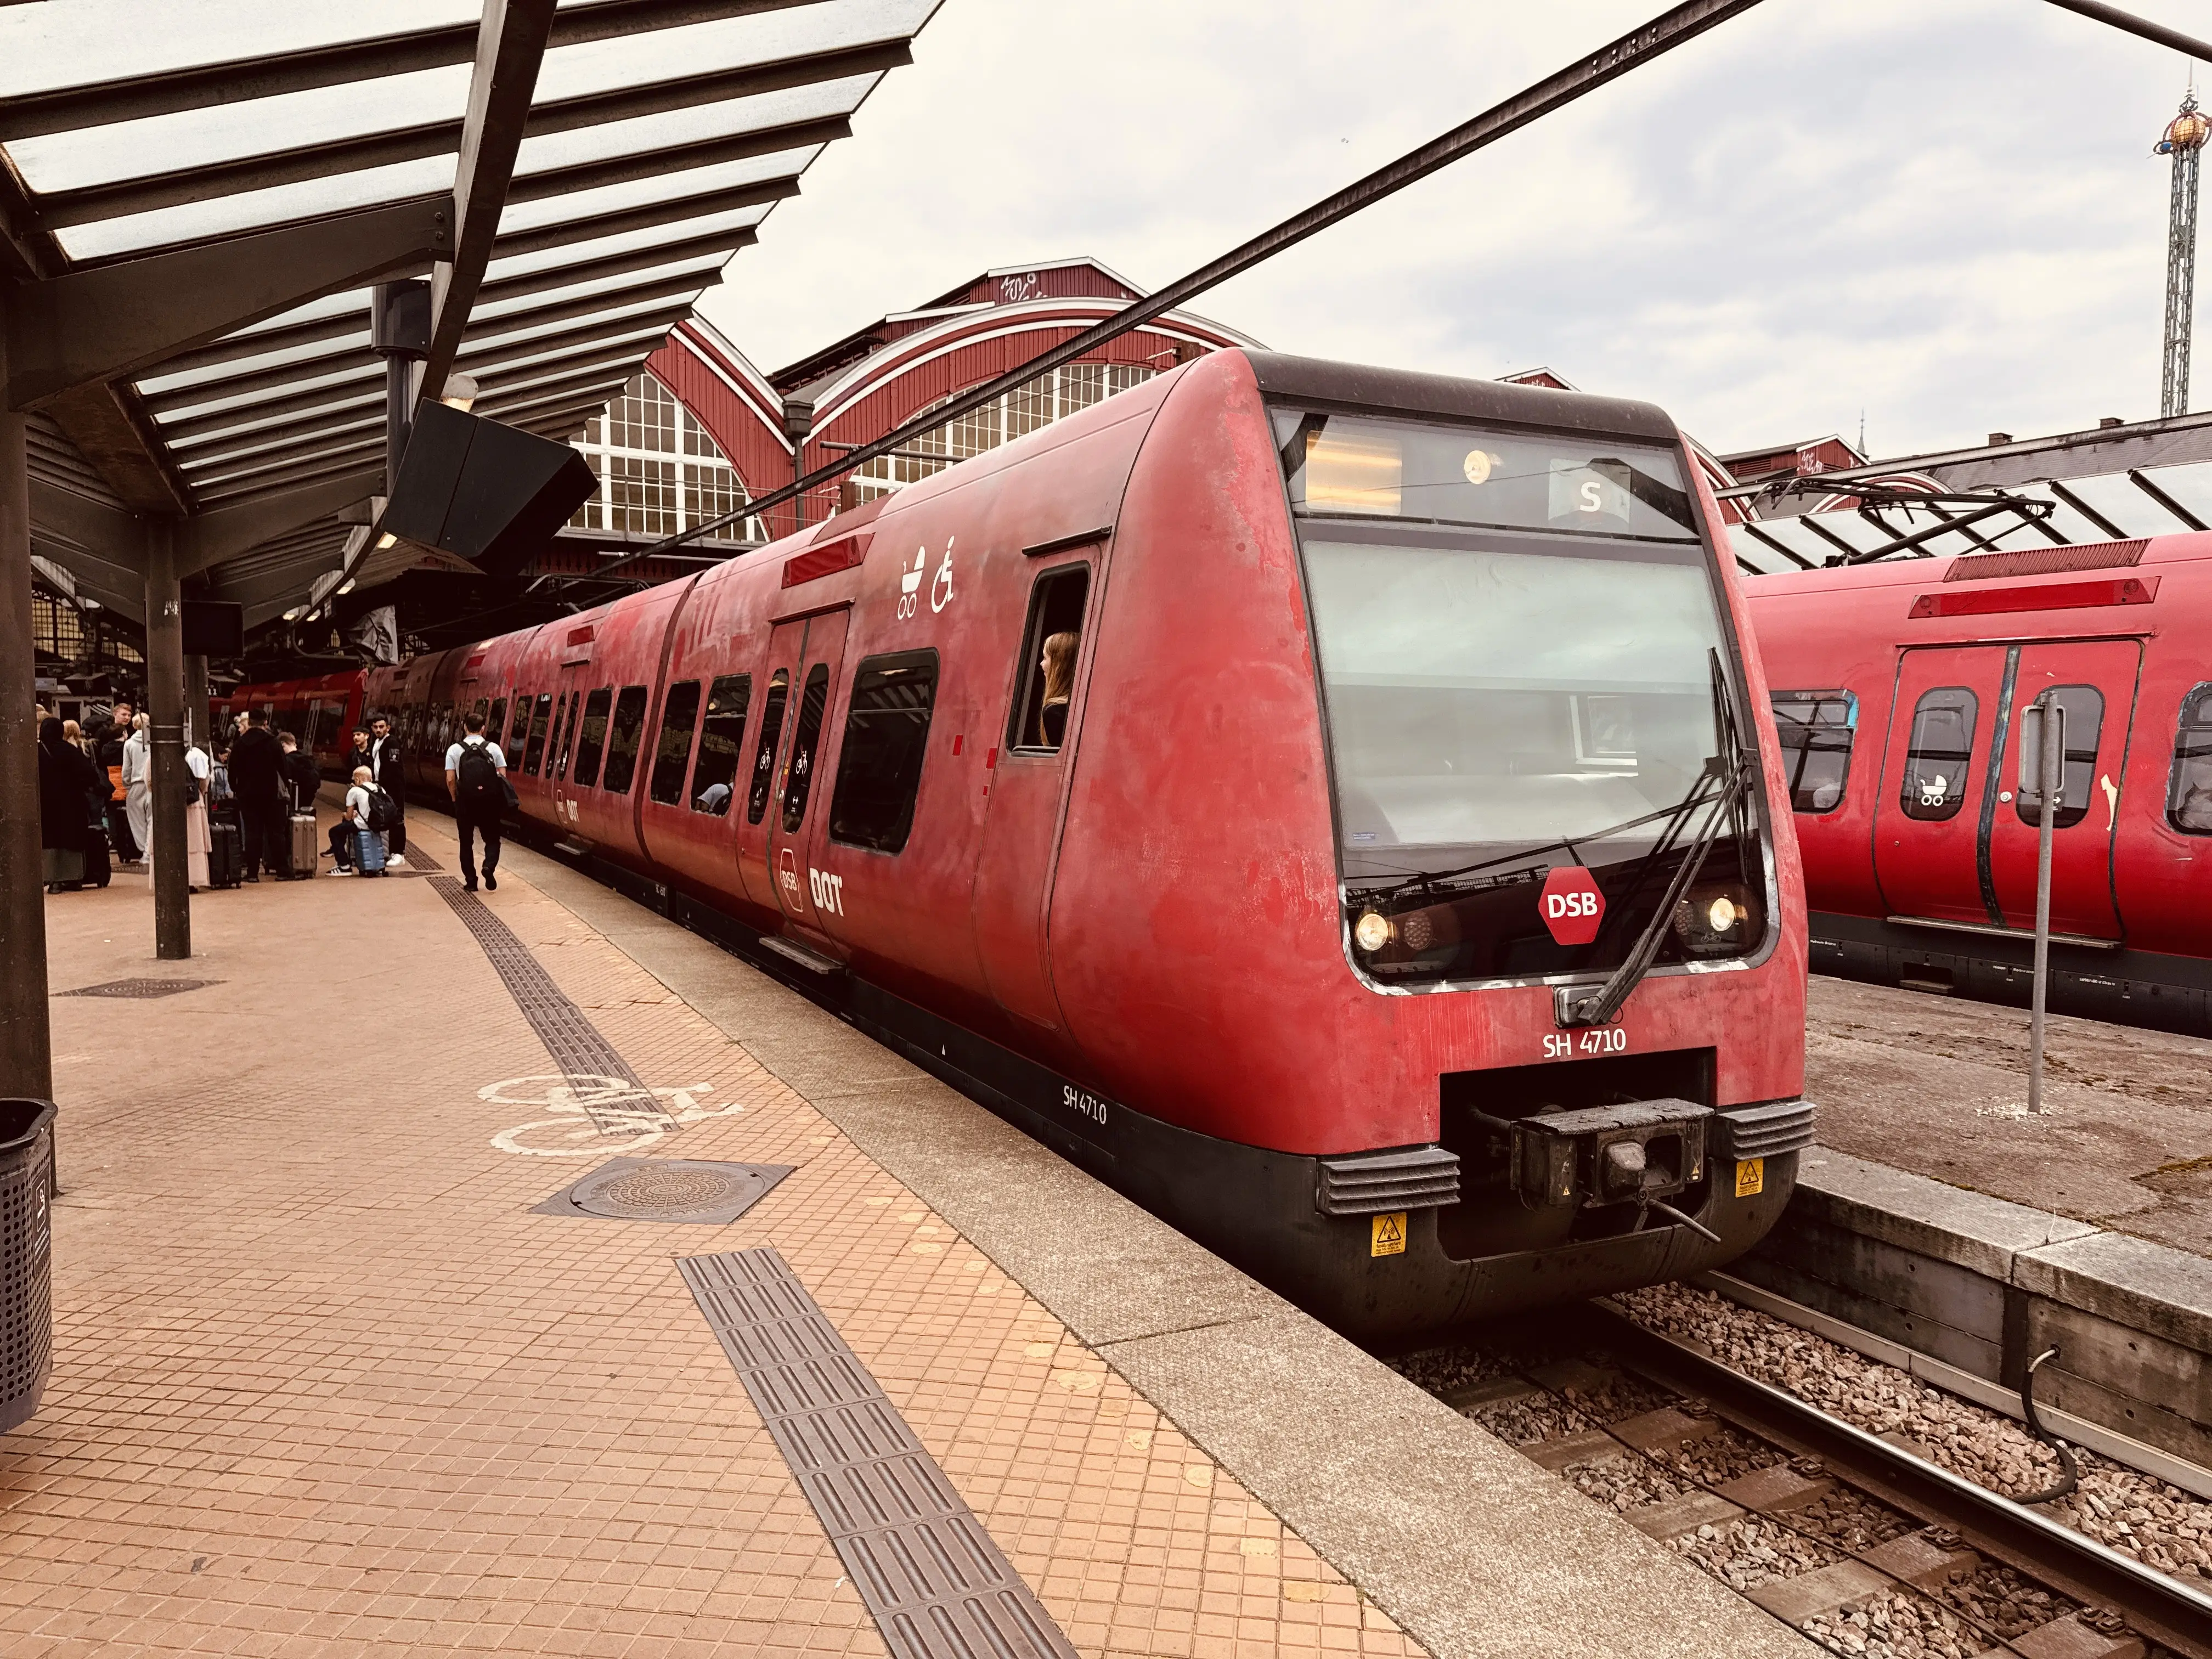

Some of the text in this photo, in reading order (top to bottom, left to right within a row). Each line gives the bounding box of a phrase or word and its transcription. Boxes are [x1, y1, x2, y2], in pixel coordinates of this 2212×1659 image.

[1579, 481, 1602, 512] S
[781, 870, 797, 891] DSB
[809, 867, 844, 917] DOT
[1547, 891, 1598, 918] DSB
[1543, 1028, 1627, 1058] SH 4710
[1063, 1085, 1107, 1125] SH 4710
